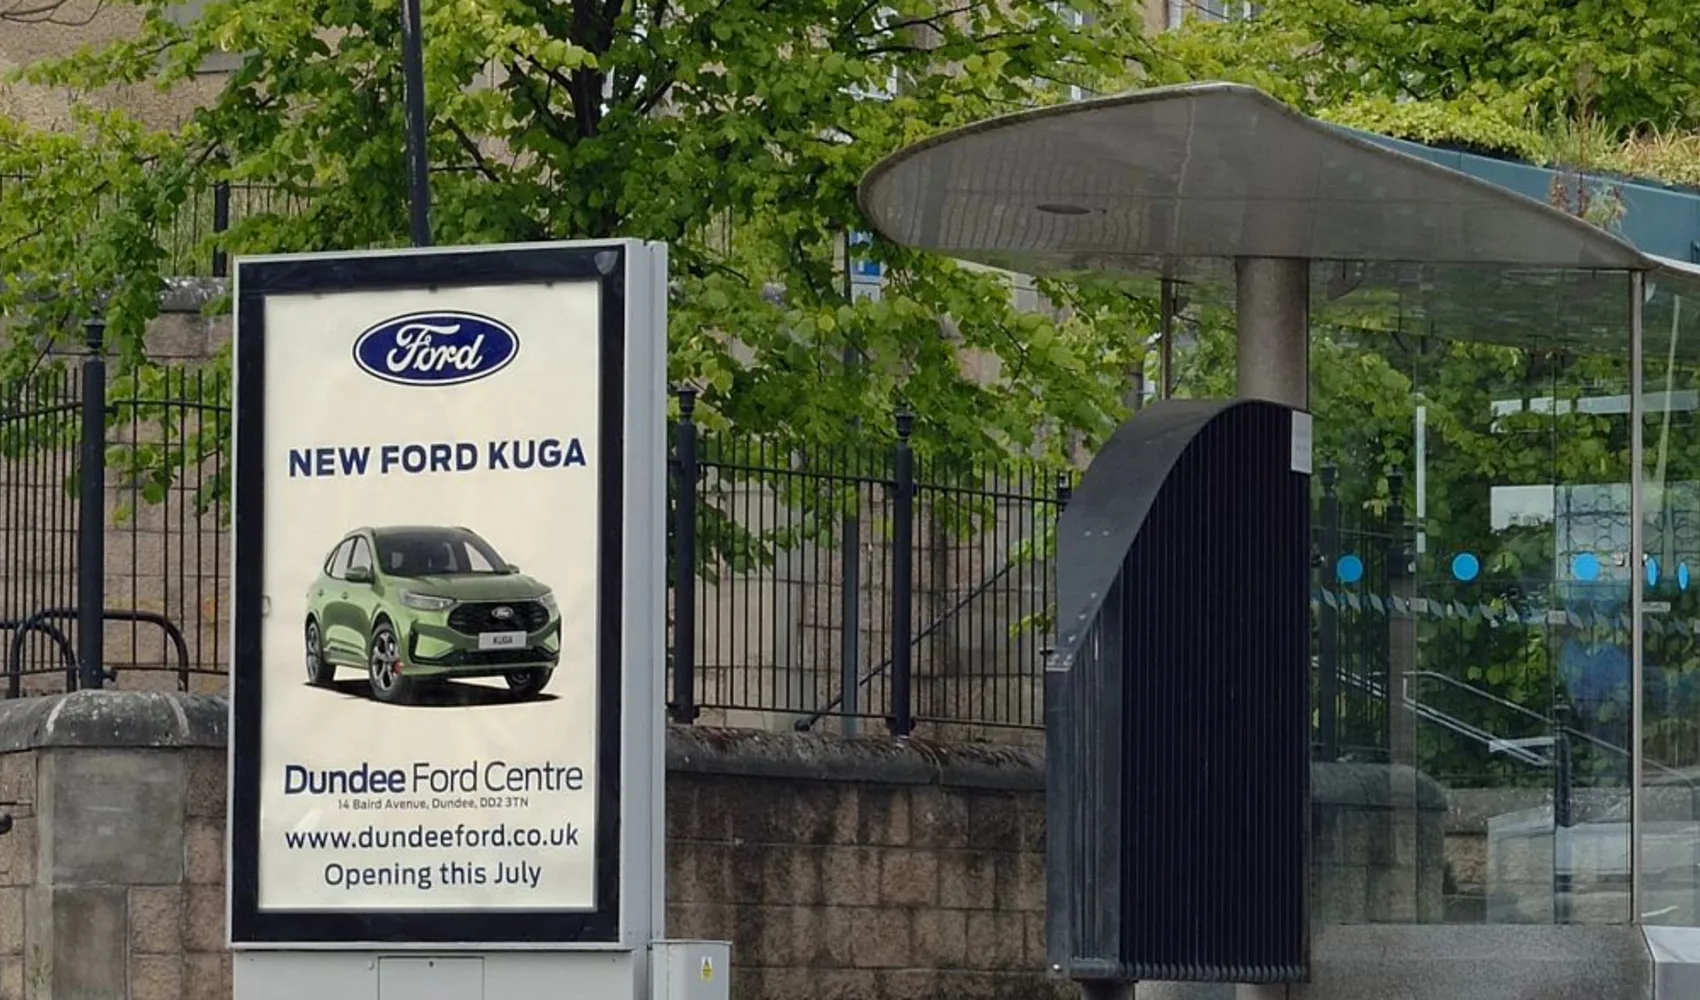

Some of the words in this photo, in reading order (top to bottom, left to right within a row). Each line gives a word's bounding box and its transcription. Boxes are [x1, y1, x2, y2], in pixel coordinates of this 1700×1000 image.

[386, 323, 483, 373] Ford
[288, 447, 370, 478] NEW
[381, 443, 478, 475] FORD
[488, 438, 586, 469] KUGA
[285, 763, 406, 794] Dundee
[413, 761, 477, 792] Ford
[485, 761, 583, 791] Centre
[338, 799, 349, 809] 14
[353, 798, 382, 810] Baird
[385, 798, 429, 811] Avenue,
[432, 797, 477, 810] Dundee,
[480, 797, 502, 808] DD2
[506, 796, 528, 807] 3TN
[285, 823, 579, 849] www.dundeeford.co.uk
[324, 863, 432, 889] Opening
[440, 862, 486, 883] this
[494, 861, 541, 888] July
